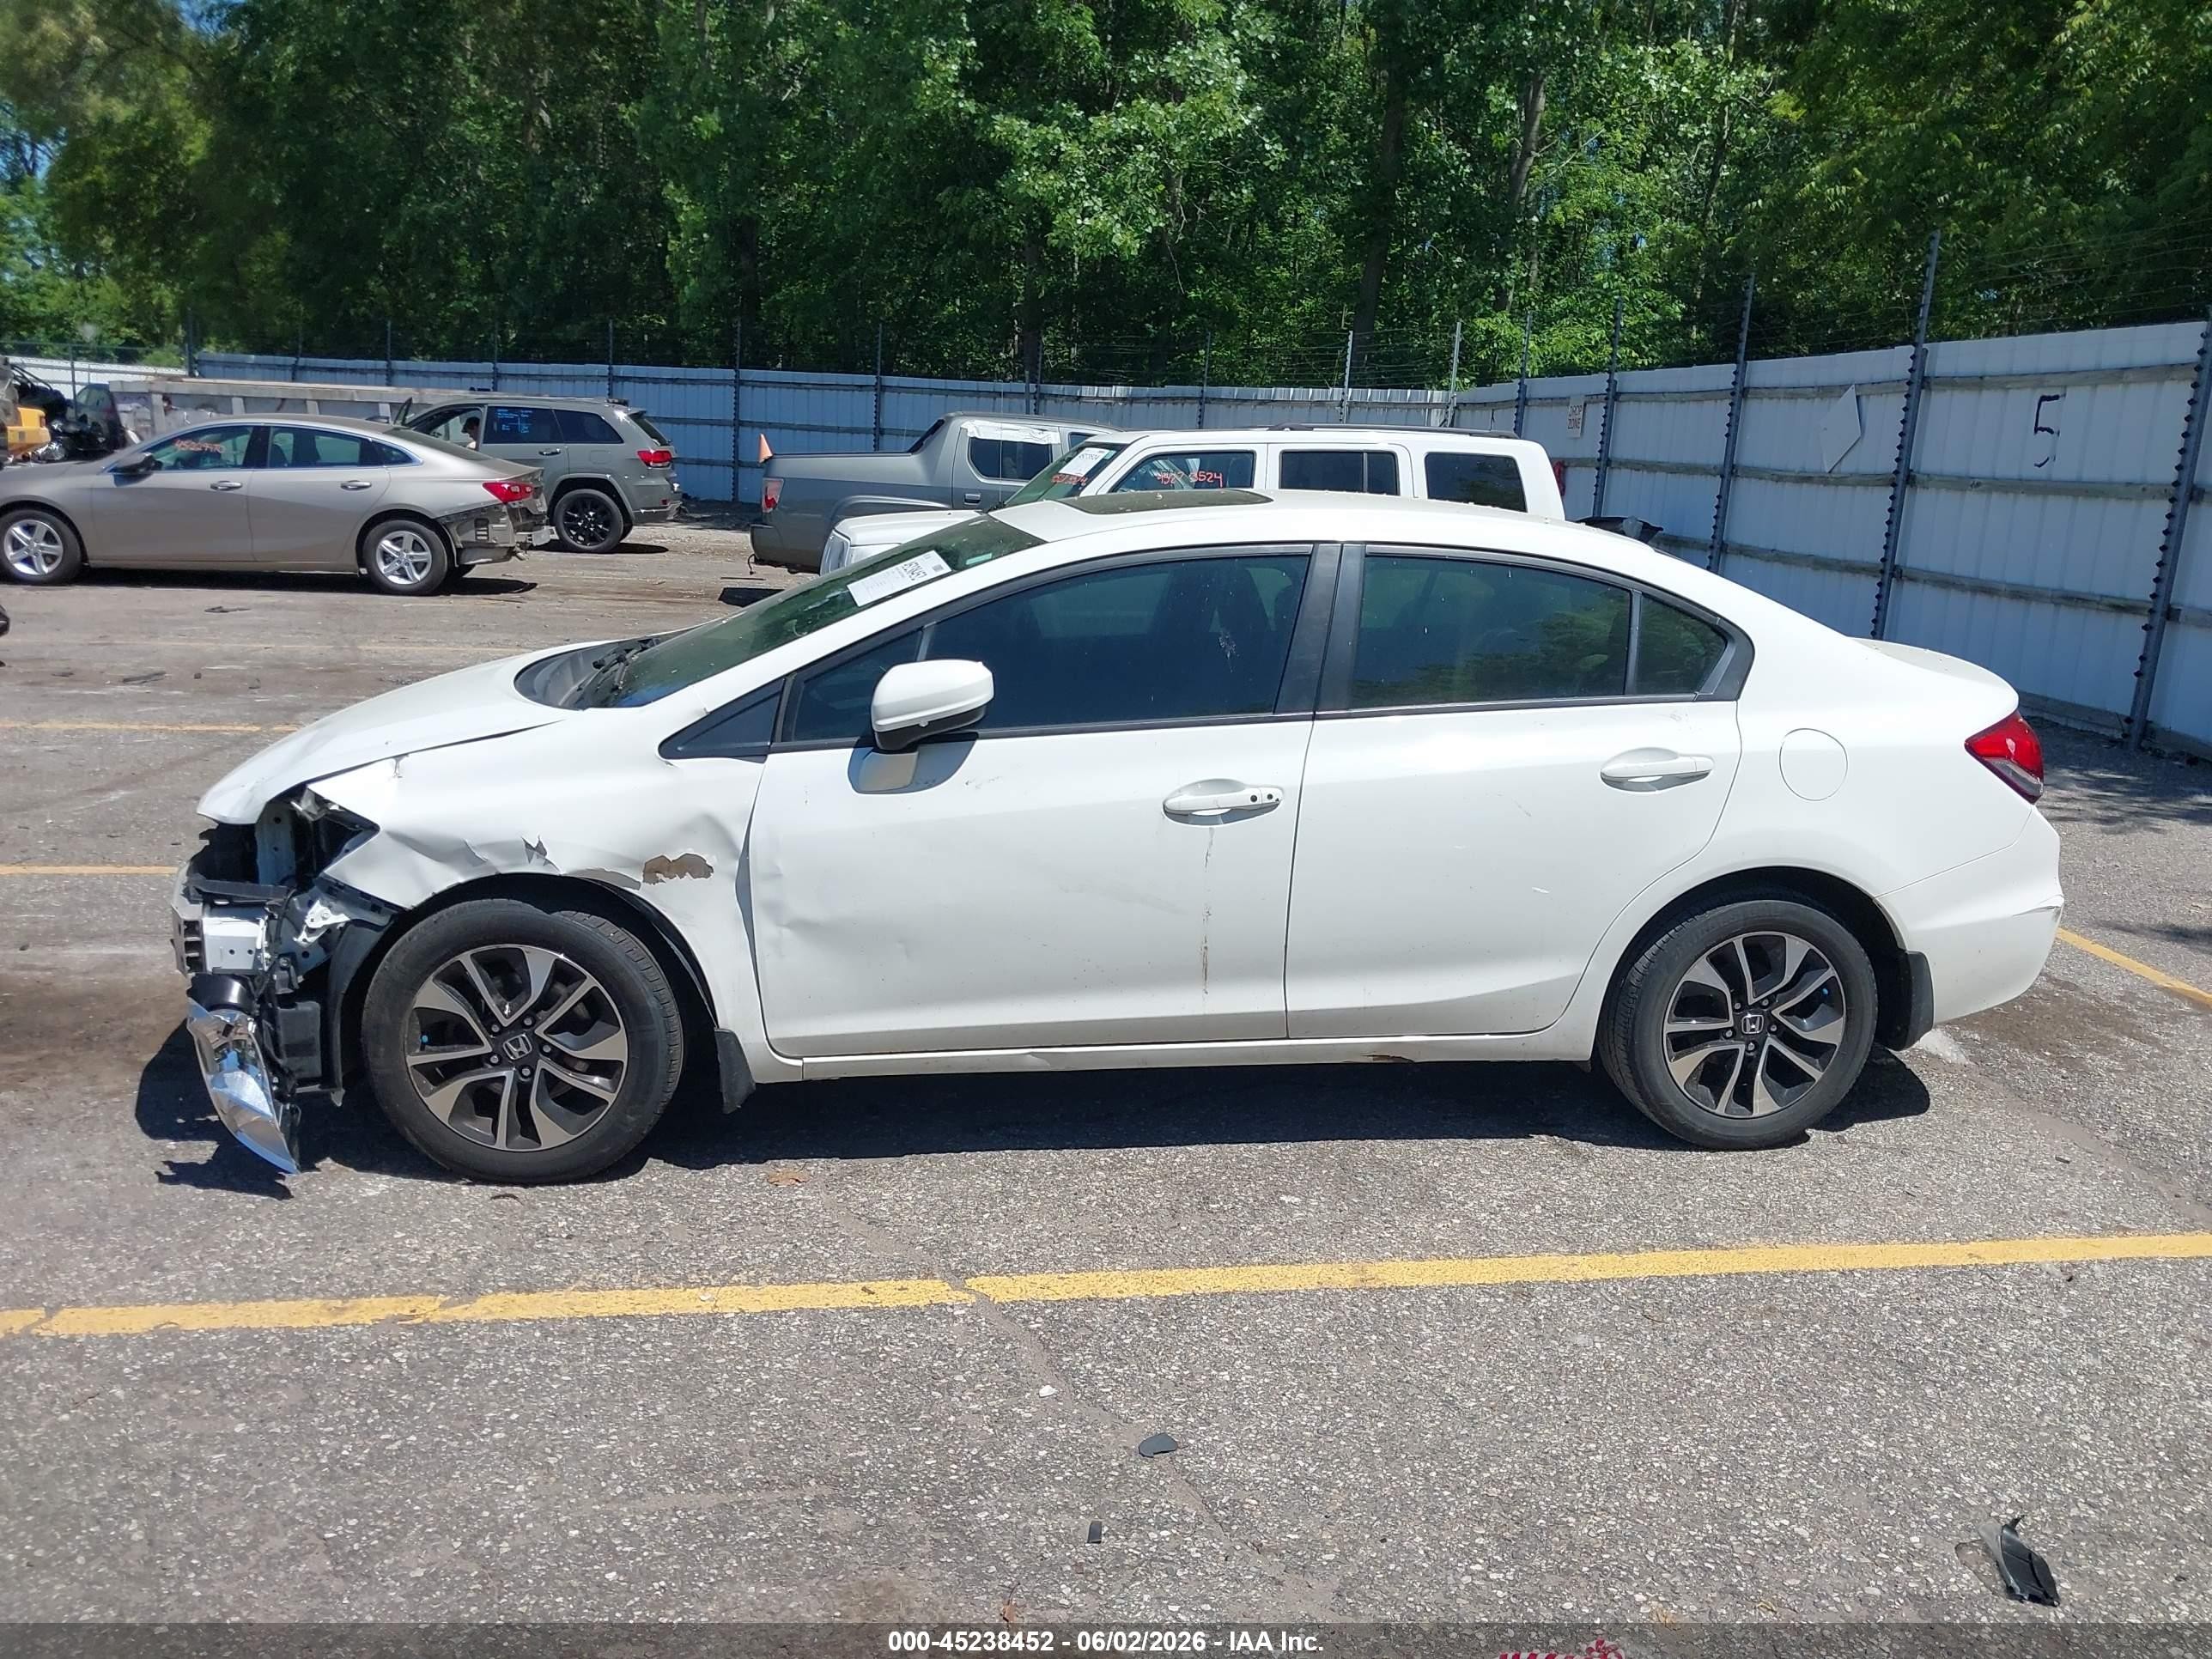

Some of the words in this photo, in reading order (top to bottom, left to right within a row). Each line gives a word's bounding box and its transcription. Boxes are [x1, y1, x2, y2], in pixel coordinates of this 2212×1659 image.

[1568, 404, 1583, 416] DROP
[1567, 417, 1581, 429] ZONE
[2033, 393, 2066, 468] 5
